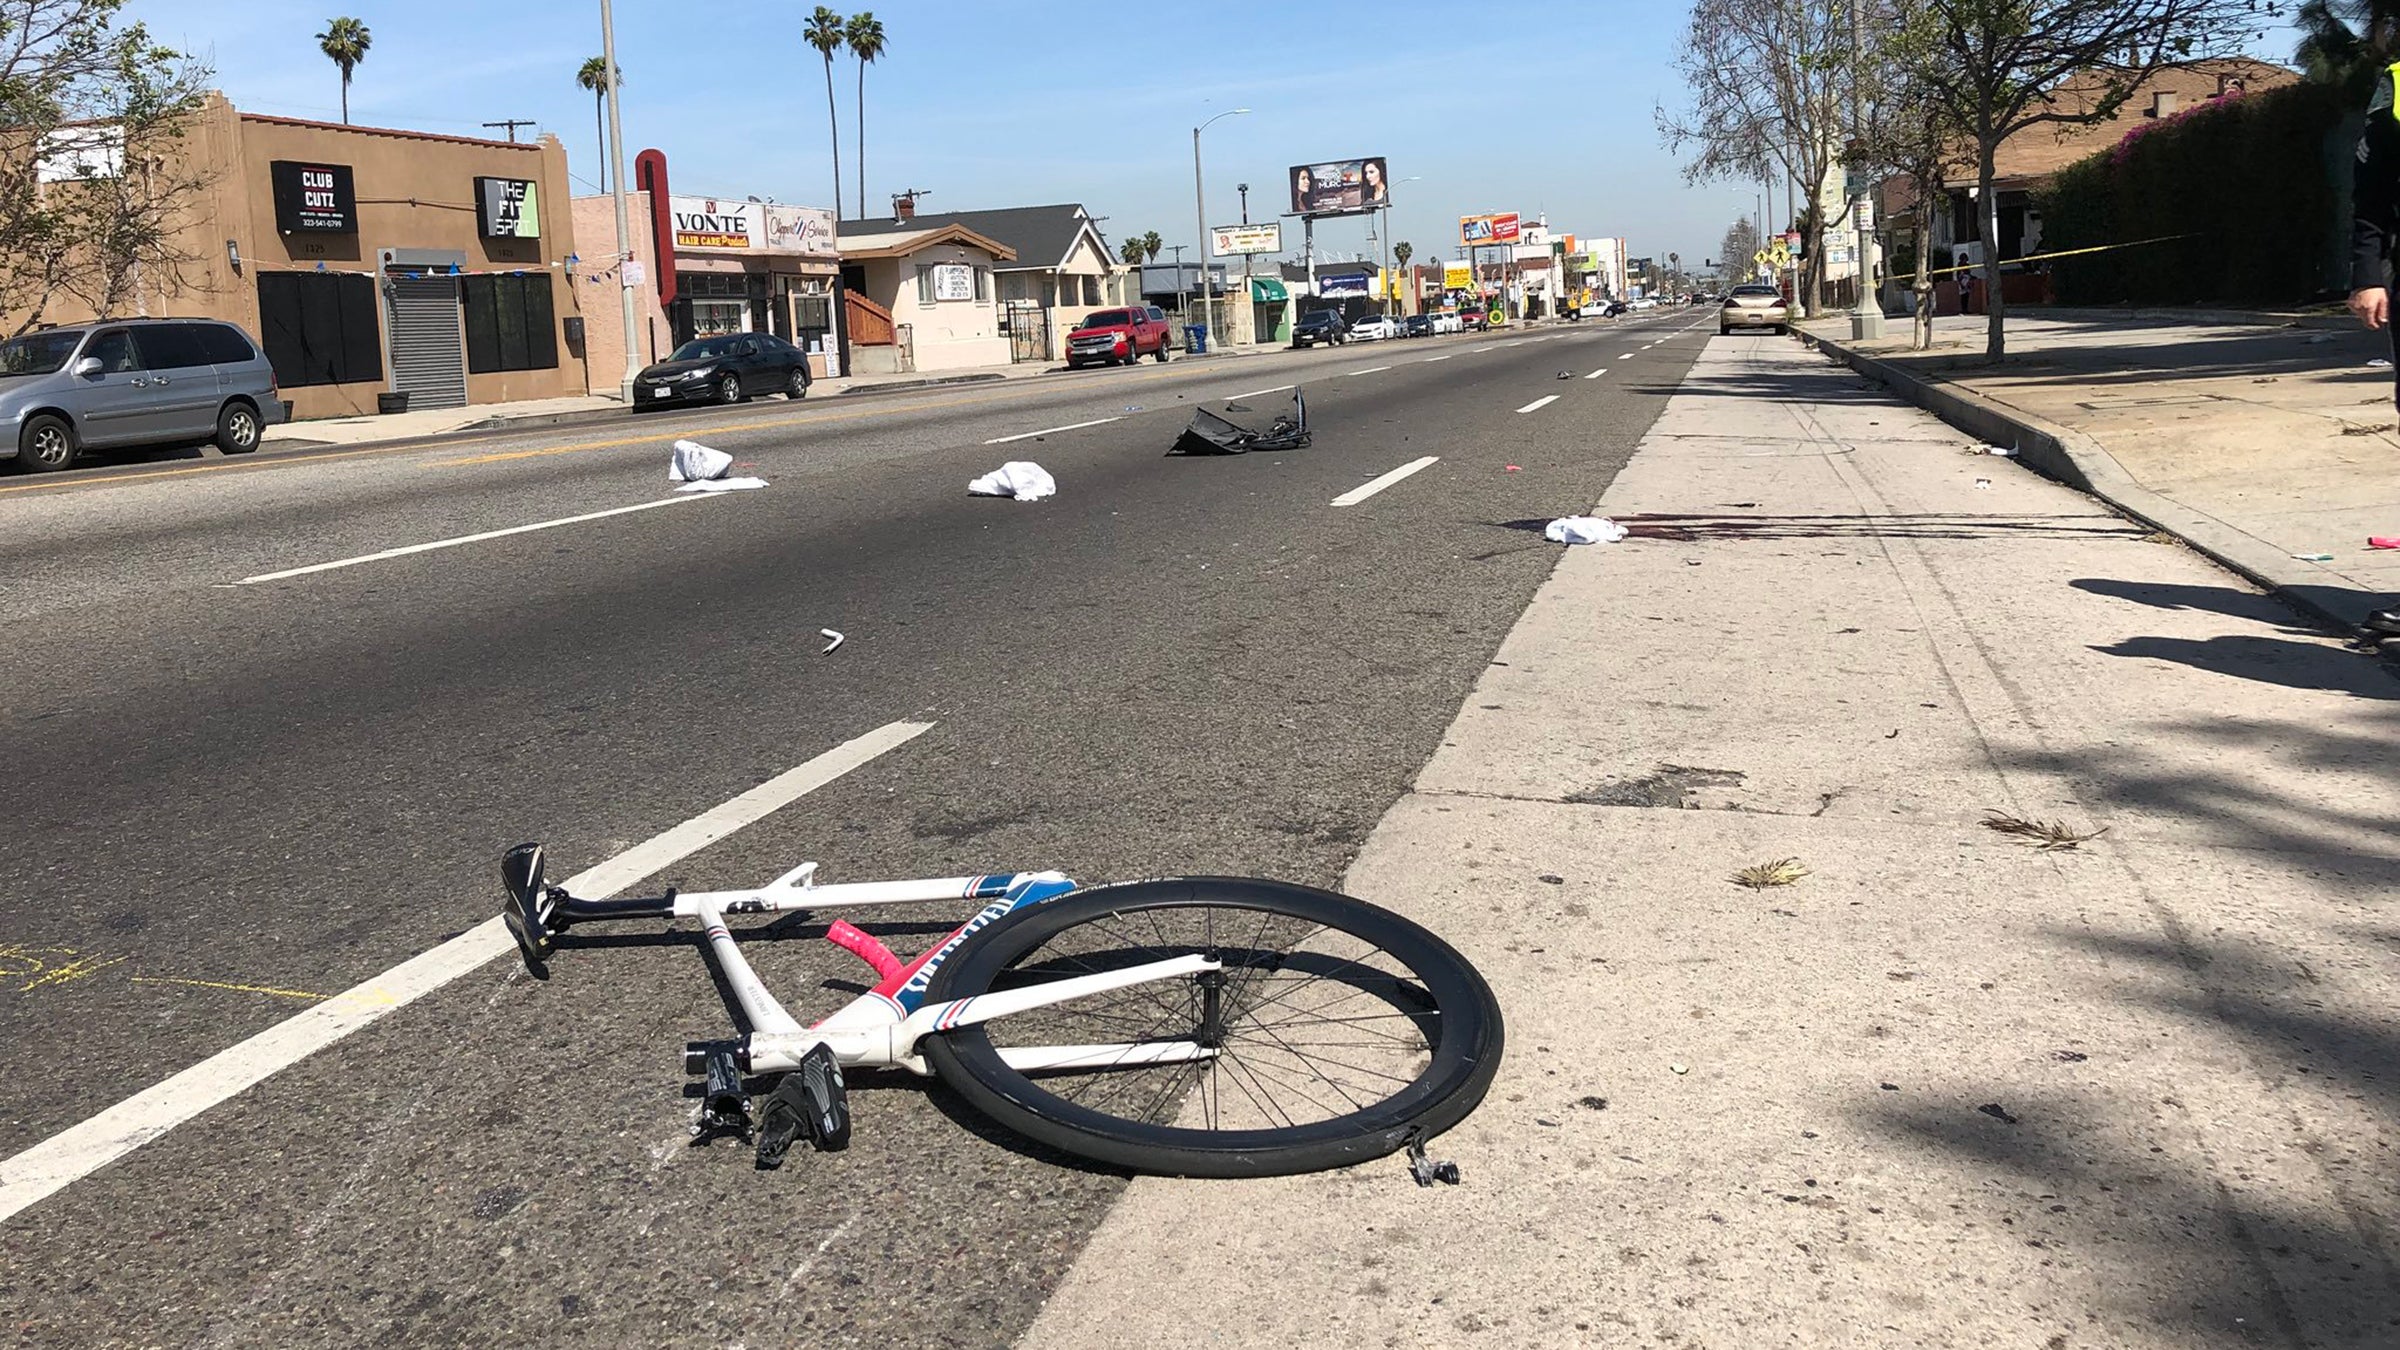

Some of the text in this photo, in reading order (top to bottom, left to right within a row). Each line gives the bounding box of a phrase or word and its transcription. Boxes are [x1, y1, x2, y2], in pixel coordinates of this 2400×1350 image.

[302, 171, 334, 189] CLUB
[497, 181, 524, 199] THE
[305, 191, 336, 208] CUTZ
[499, 200, 525, 217] FIT
[495, 218, 530, 237] SPOT
[676, 205, 747, 233] VONTÉ
[678, 234, 700, 246] HAIR
[700, 236, 721, 246] CARE
